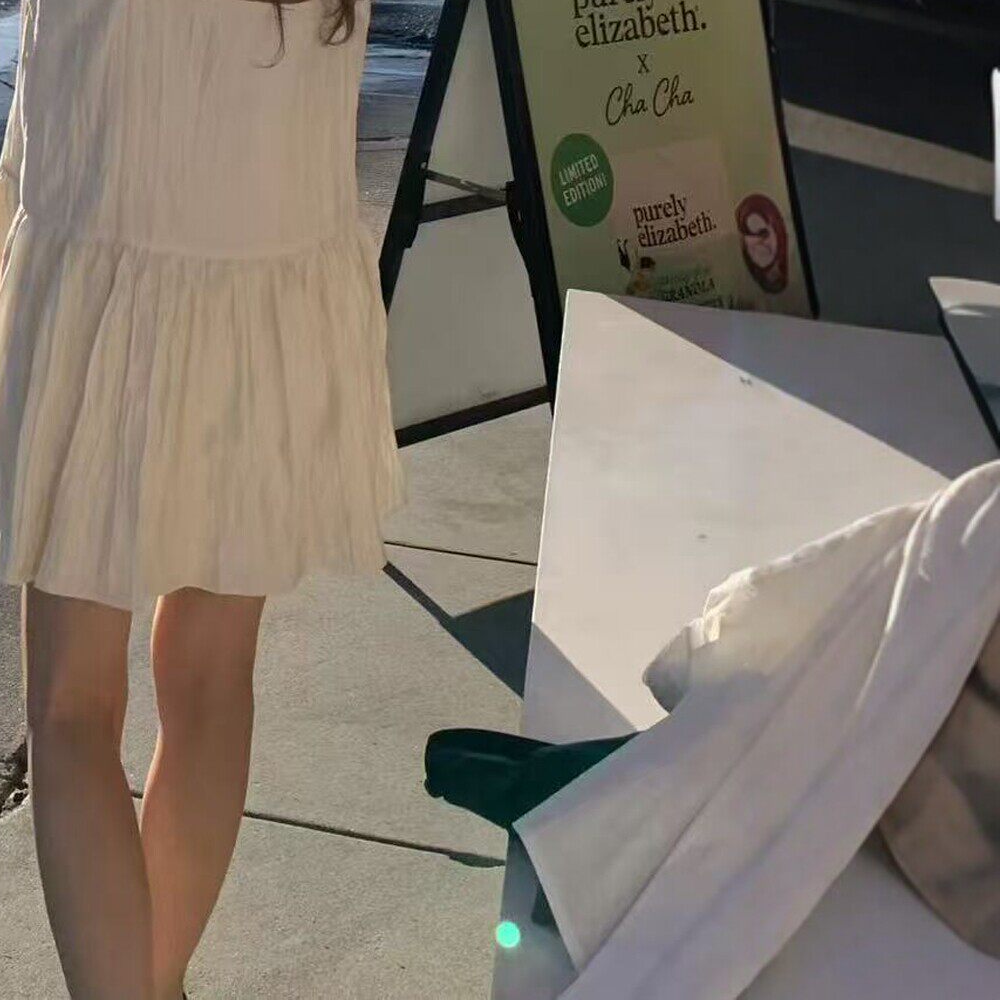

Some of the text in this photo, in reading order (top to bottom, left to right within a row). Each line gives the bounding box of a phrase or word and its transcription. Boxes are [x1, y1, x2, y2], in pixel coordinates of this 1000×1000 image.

[575, 1, 707, 48] elizabeth.
[606, 74, 694, 126] Cha Cha
[559, 153, 600, 186] LIMITED
[563, 172, 608, 207] EDITION!
[632, 193, 687, 229] purely
[638, 211, 717, 247] elizabeth.
